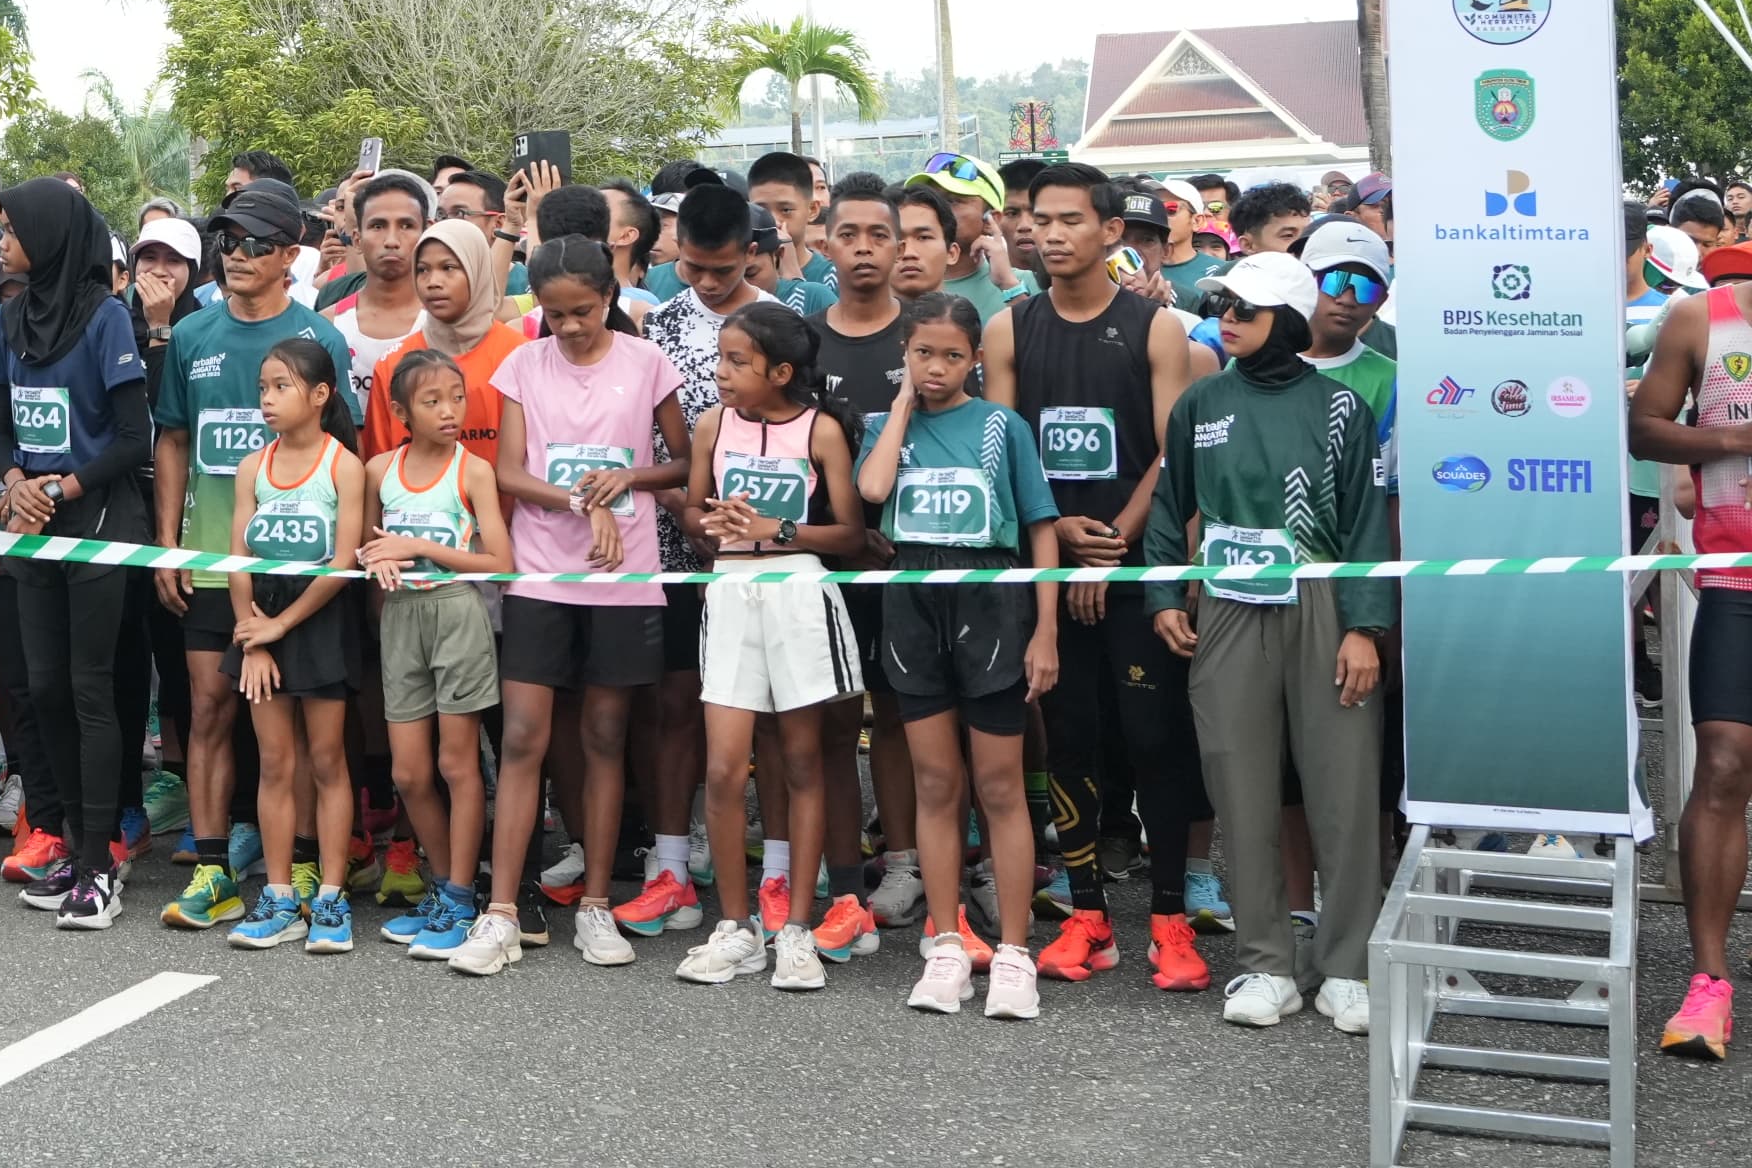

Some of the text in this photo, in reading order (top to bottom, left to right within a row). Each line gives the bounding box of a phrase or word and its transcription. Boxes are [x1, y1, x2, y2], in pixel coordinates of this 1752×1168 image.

[1435, 224, 1589, 241] bankaltimtara
[1443, 310, 1582, 326] BPJS Kesehatan
[1444, 327, 1583, 337] Badan Penyelenggara Jaminan Sosial
[213, 427, 265, 450] 1126
[1047, 428, 1101, 452] 1396
[1508, 458, 1592, 493] STEFFI
[728, 473, 799, 503] 2577
[912, 489, 971, 514] 2119
[254, 518, 319, 543] 2435
